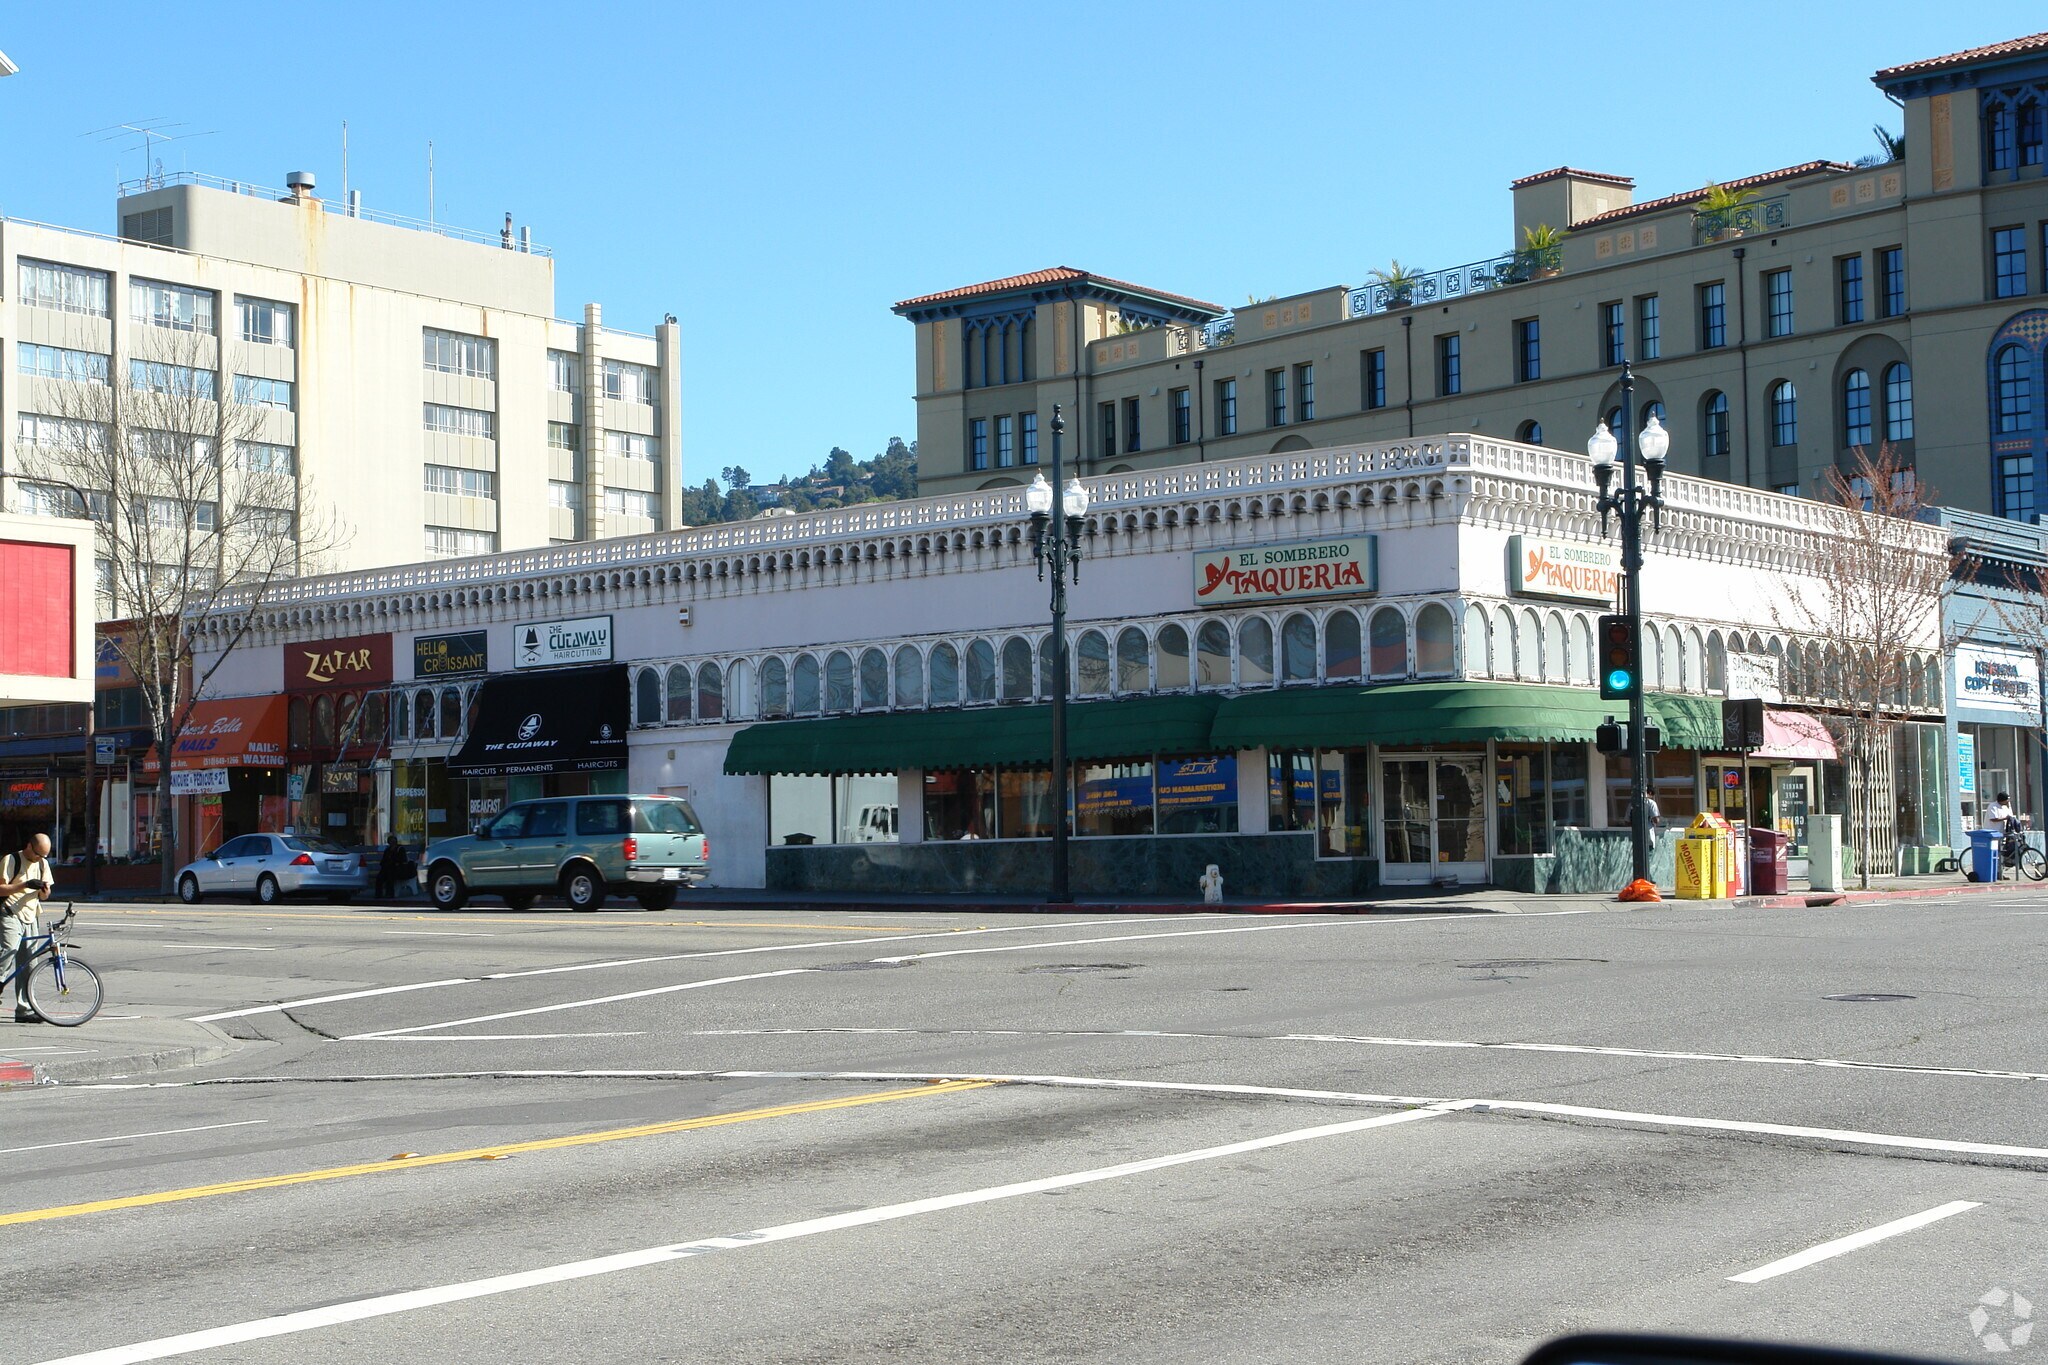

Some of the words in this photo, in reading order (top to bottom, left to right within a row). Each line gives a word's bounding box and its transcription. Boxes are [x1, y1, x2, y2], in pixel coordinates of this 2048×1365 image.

[1239, 553, 1259, 566] EL
[1264, 544, 1350, 564] SOMBRERO
[1549, 546, 1561, 559] EL
[1564, 548, 1611, 566] SOMBRERO
[1225, 560, 1365, 596] TAQUERIA
[1541, 561, 1618, 595] TAQUERIA
[549, 625, 562, 635] THE
[549, 629, 607, 650] CUTAWAY
[553, 648, 602, 660] HAIRCUTTING
[302, 648, 373, 683] ZATAR
[209, 717, 244, 735] Bella
[177, 738, 219, 752] NAILS
[485, 743, 503, 751] THE
[506, 740, 558, 750] CUTAWAY
[242, 753, 285, 765] WAXING
[577, 760, 618, 770] HAIRCUTS
[462, 767, 497, 776] HAIRCUTS
[505, 763, 554, 774] PERMANENTS
[327, 771, 353, 785] ZATAR
[394, 787, 426, 798] ESPRESSO
[470, 798, 501, 814] BREAKFAST
[1680, 842, 1701, 886] MOMENTO
